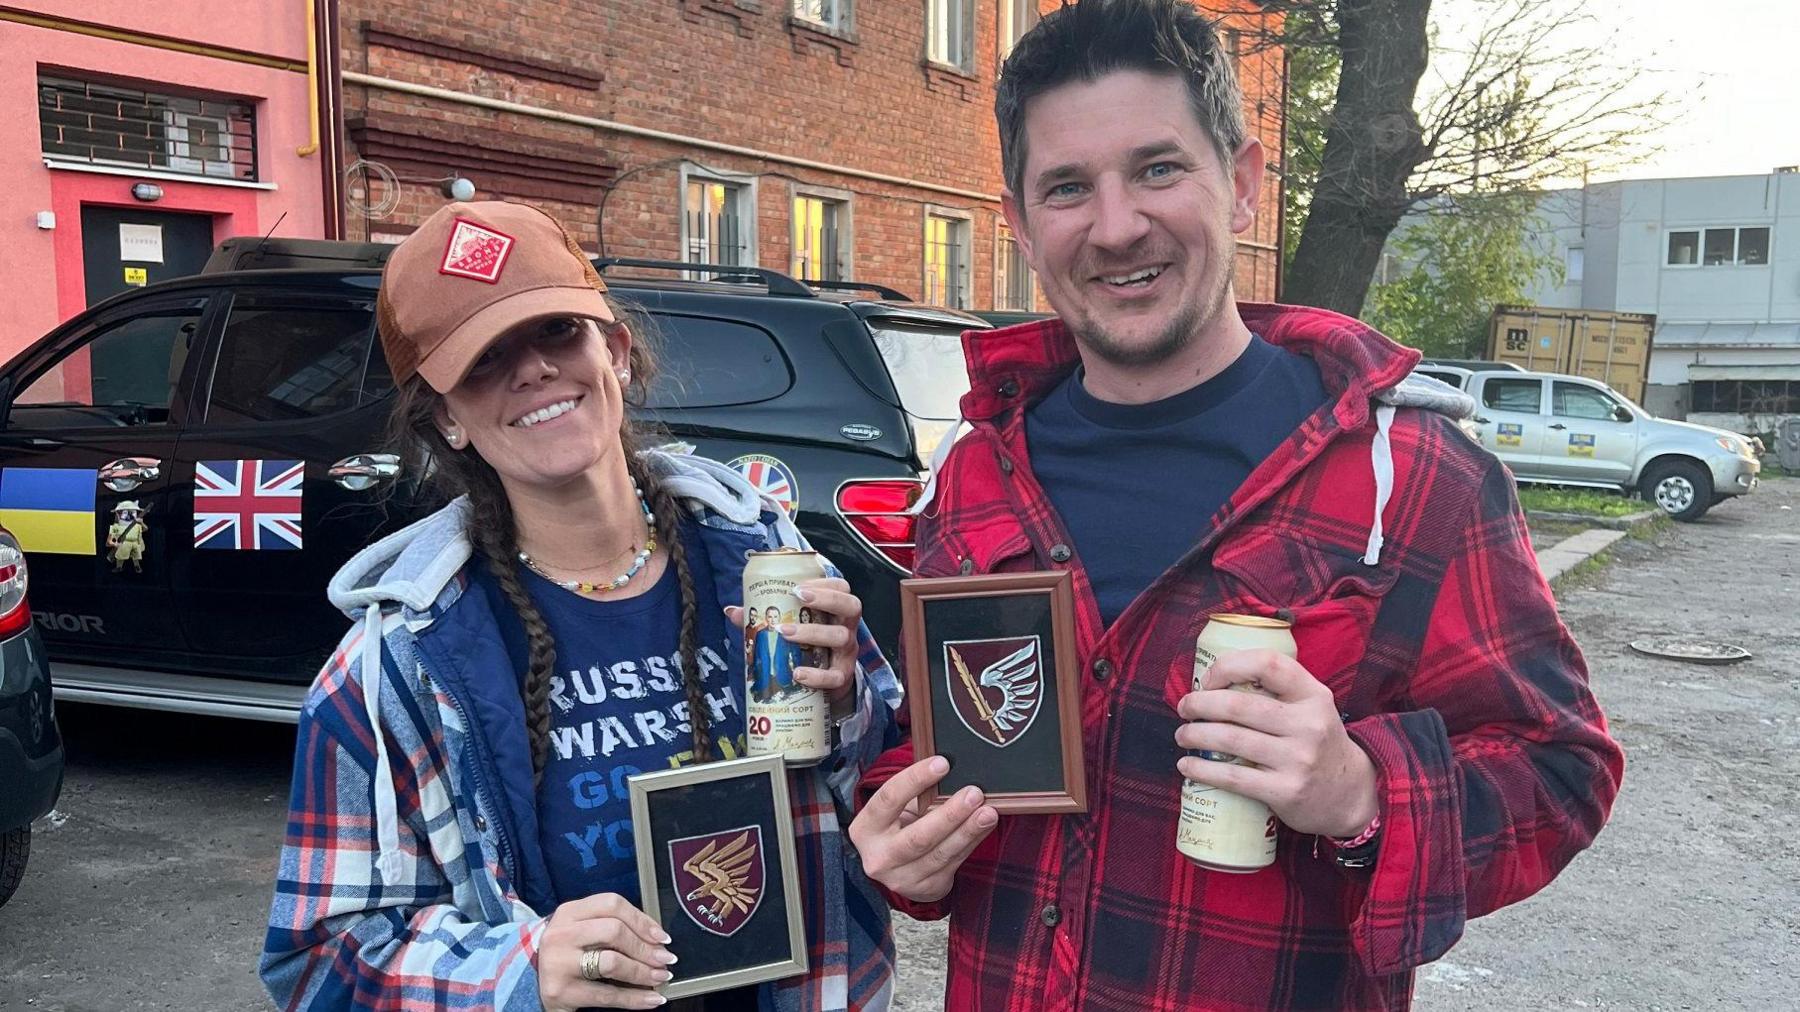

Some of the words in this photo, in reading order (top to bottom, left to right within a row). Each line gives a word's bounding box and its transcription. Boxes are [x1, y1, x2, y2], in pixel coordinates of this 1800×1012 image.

[31, 611, 106, 634] RIOR
[549, 638, 730, 714] RUSSIA
[792, 705, 814, 713] СОРТ
[550, 686, 740, 761] WARSH
[749, 715, 772, 735] 20
[1195, 796, 1217, 808] СОРТ
[1264, 815, 1277, 838] 2
[564, 819, 634, 870] YO
